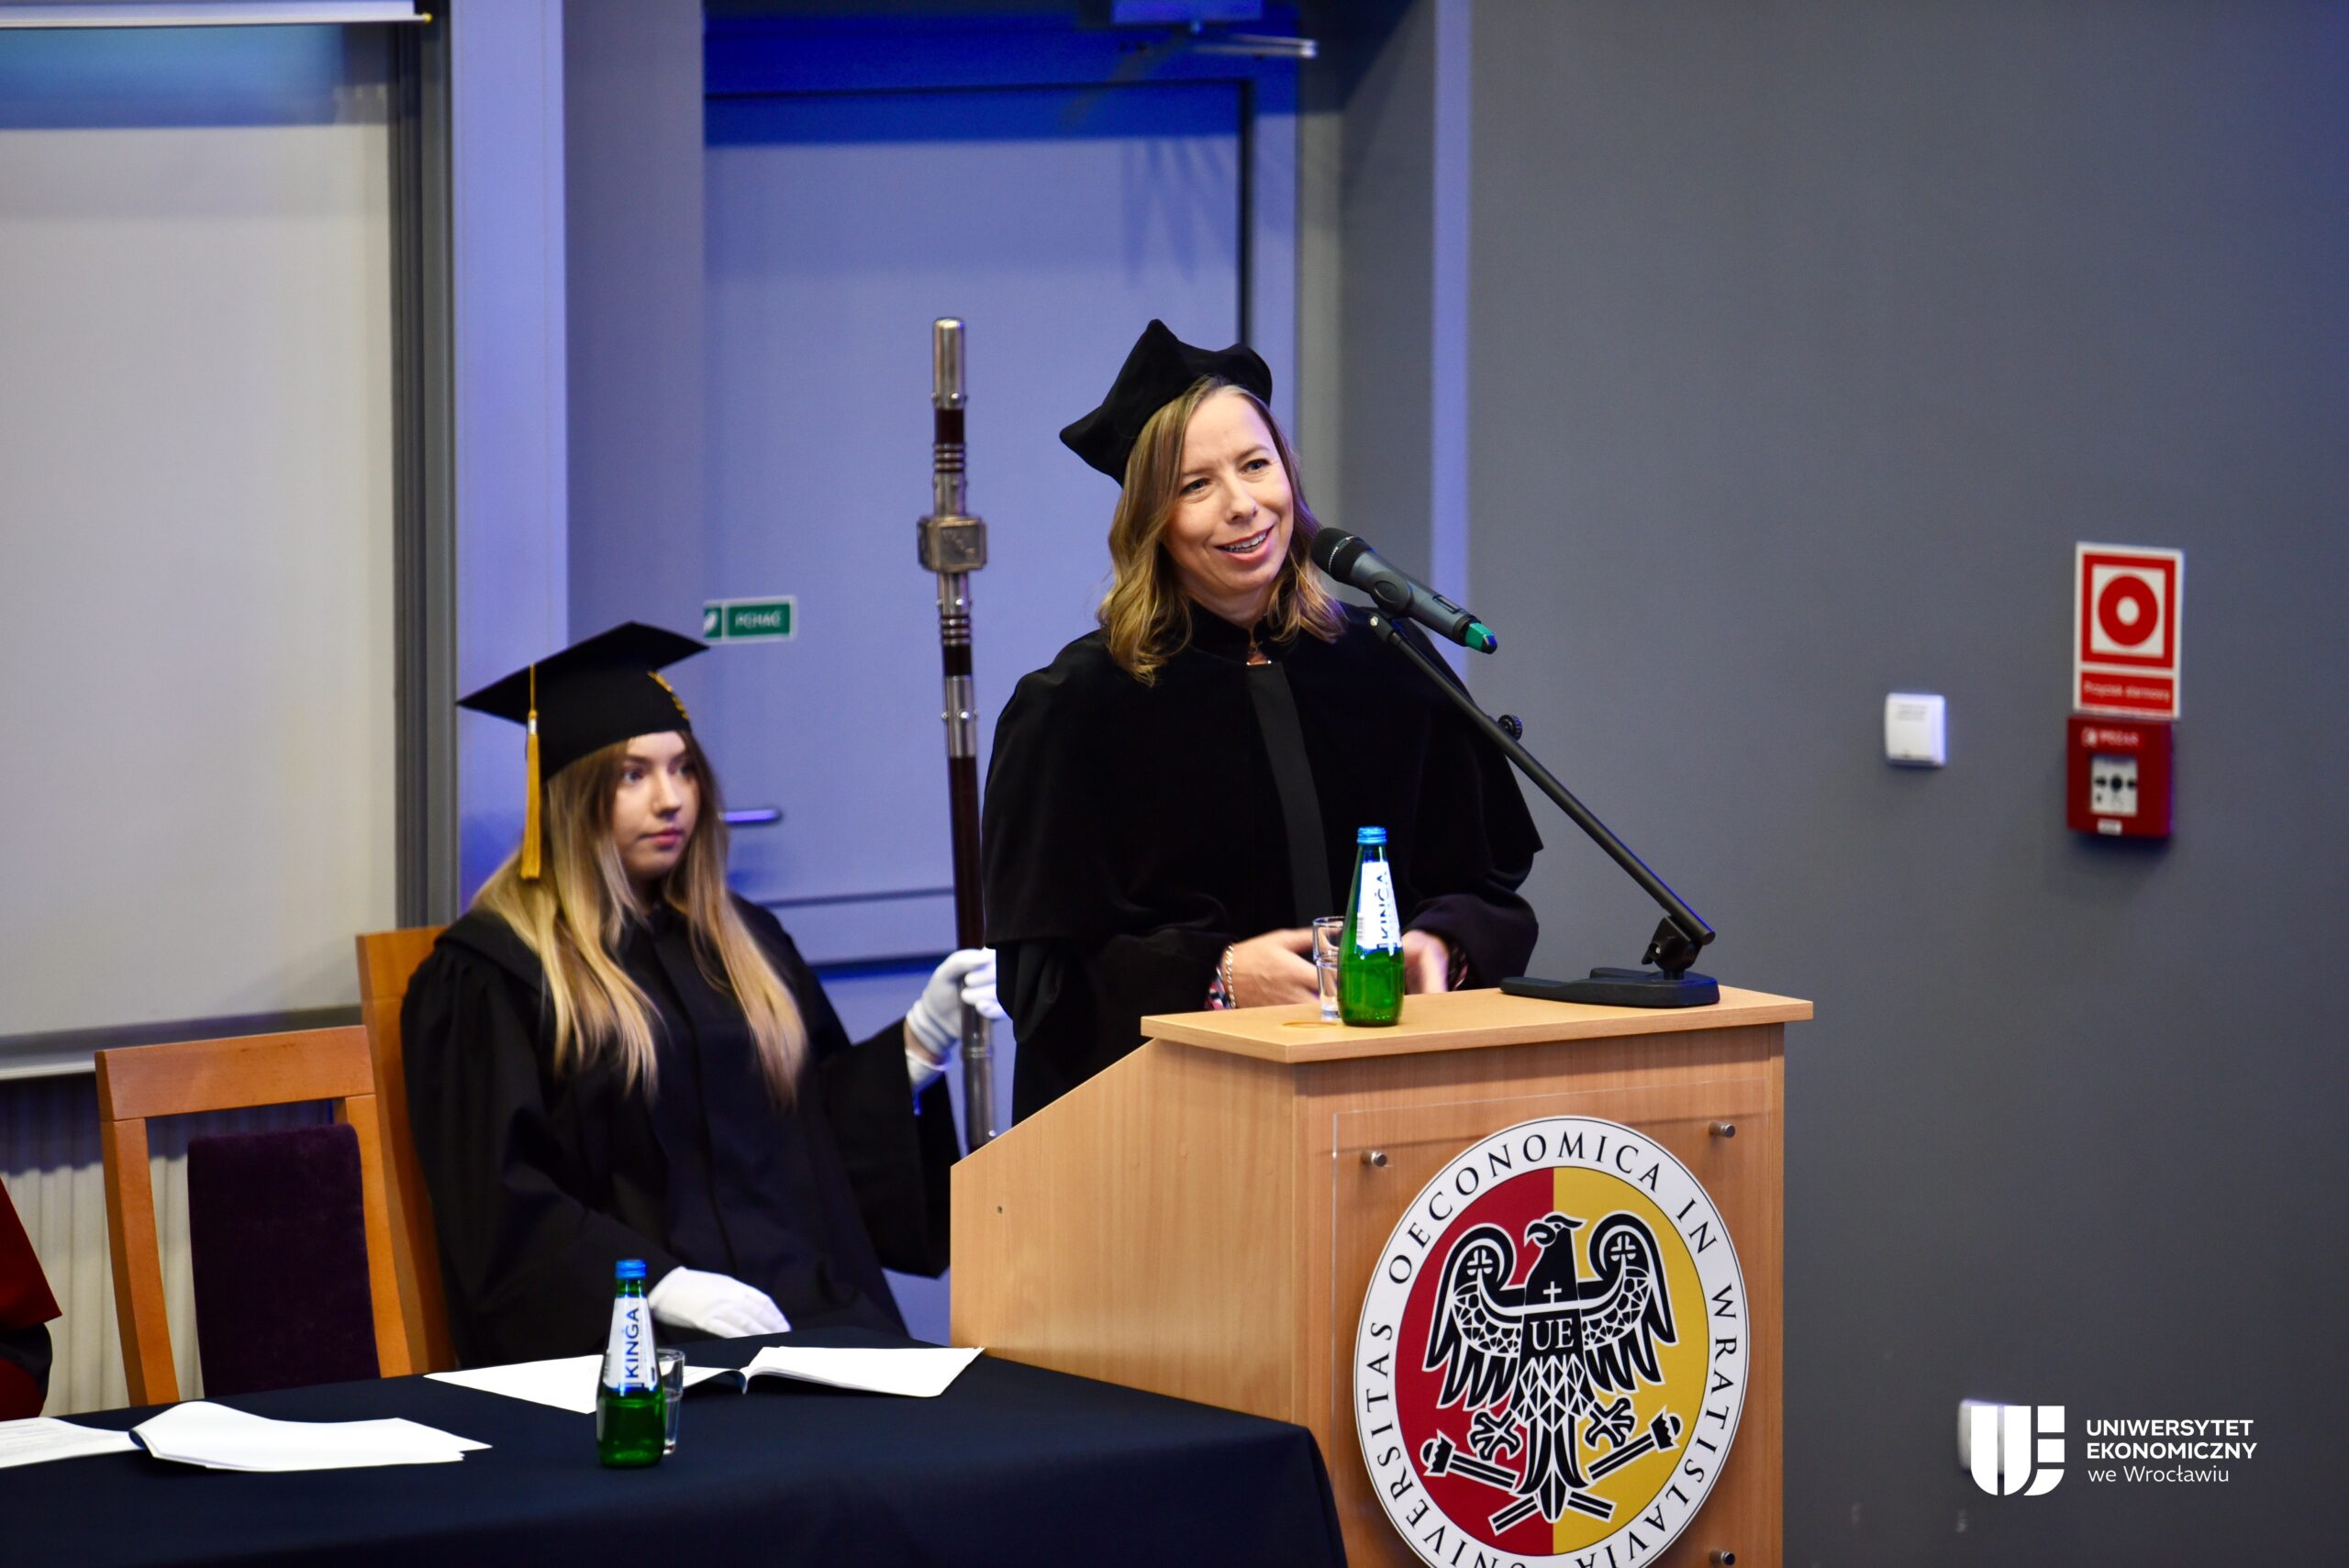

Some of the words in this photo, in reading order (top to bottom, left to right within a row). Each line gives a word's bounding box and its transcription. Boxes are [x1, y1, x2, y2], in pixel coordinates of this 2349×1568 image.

[1389, 1131, 1661, 1284] OECONOMICA
[1675, 1198, 1718, 1255] IN
[624, 1307, 640, 1379] KINGA
[1530, 1318, 1575, 1351] UE
[1365, 1321, 1527, 1568] NIVERSITAS
